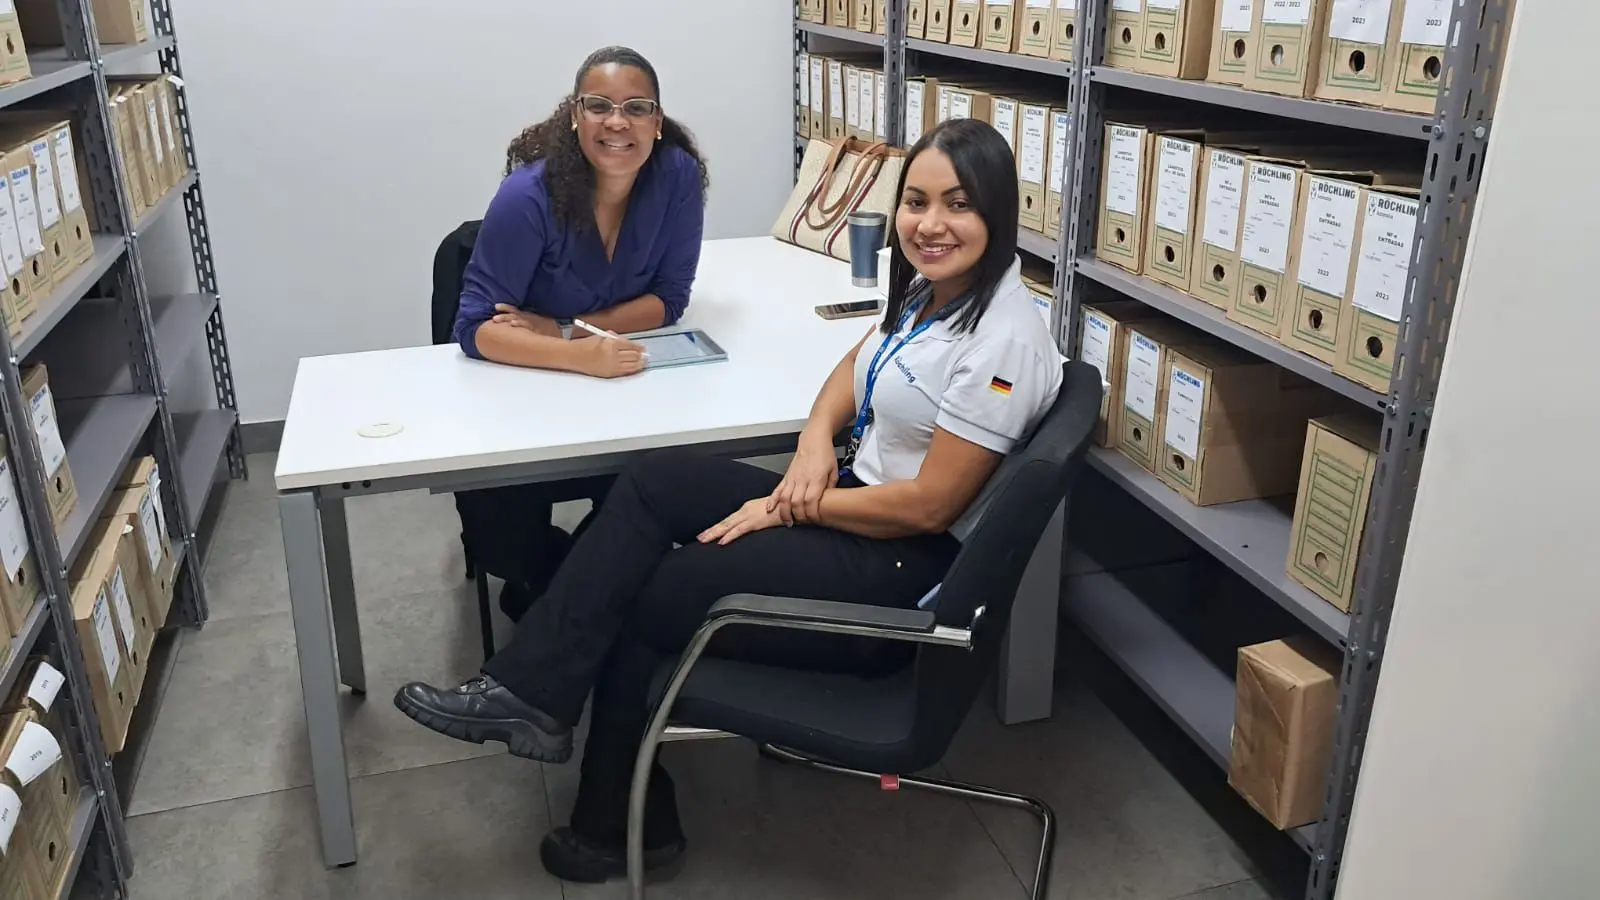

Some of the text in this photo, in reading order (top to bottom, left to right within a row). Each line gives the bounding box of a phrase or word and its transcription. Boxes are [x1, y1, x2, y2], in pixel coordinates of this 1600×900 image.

[1352, 16, 1366, 25] 2023
[1426, 18, 1442, 27] 2023
[1257, 166, 1292, 182] RÖCHLING
[1318, 182, 1356, 200] RÖCHLING
[1377, 198, 1417, 217] RÖCHLIN
[1318, 218, 1342, 229] ENTRADAS
[1377, 236, 1405, 249] ENTRADAS
